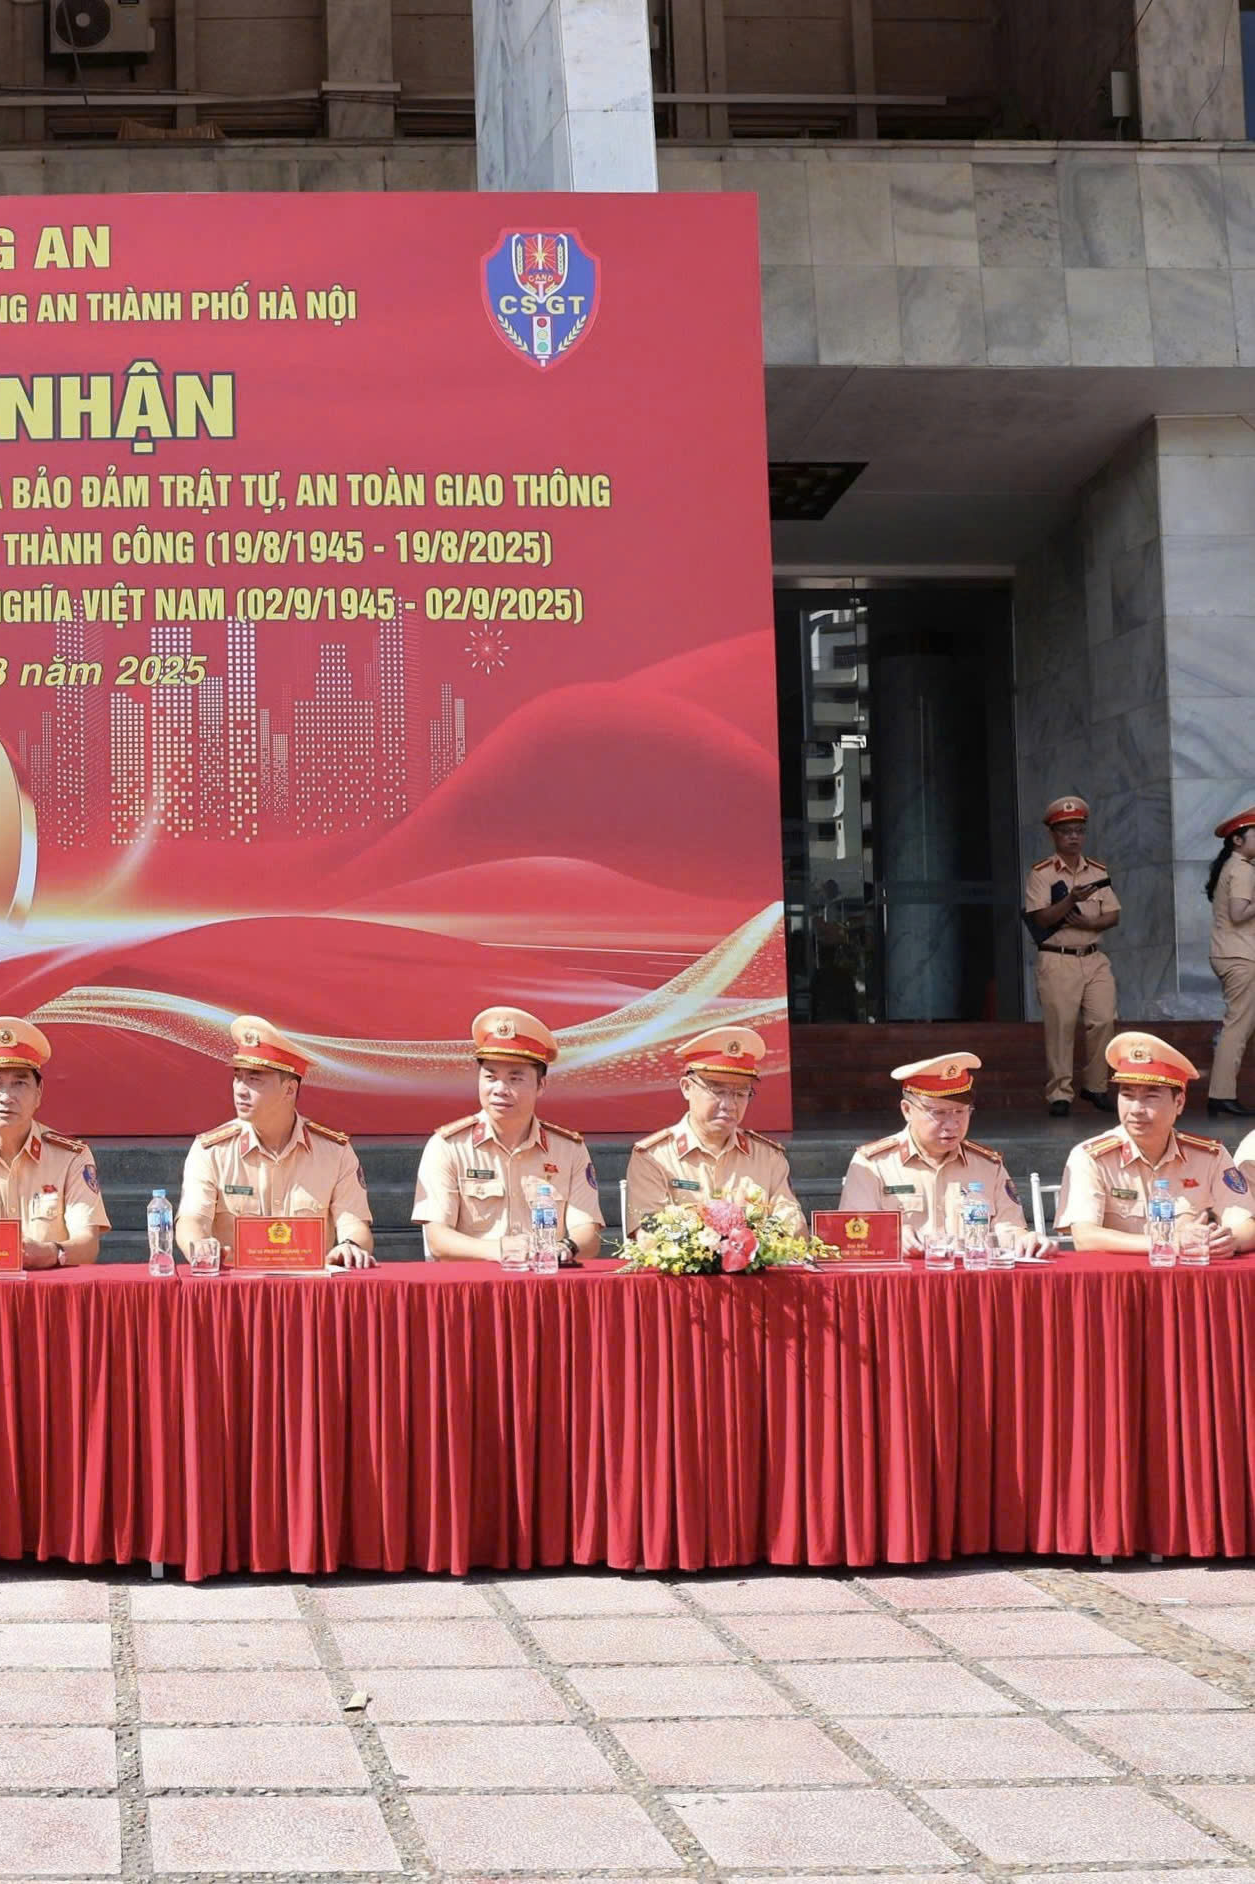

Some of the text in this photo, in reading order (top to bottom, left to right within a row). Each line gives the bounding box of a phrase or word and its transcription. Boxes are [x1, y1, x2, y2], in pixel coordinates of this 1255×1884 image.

[34, 223, 111, 270] AN
[527, 273, 554, 283] CAND
[36, 293, 78, 324] AN
[87, 287, 182, 321] THÀNH
[190, 283, 250, 321] PHỐ
[256, 284, 298, 321] HÀ
[304, 284, 357, 324] NỘI
[11, 469, 73, 510] BẢO
[80, 468, 150, 509] ĐẢM
[160, 467, 233, 513] TRẬT
[240, 471, 290, 515] TỰ,
[296, 471, 338, 508] AN
[345, 471, 426, 507] TOÀN
[434, 473, 504, 508] GIAO
[512, 468, 611, 509] THÔNG
[3, 527, 103, 566] THÀNH
[112, 525, 195, 565] CÔNG
[205, 529, 365, 566] (19/8/1945
[394, 529, 552, 566] 19/8/2025)
[80, 583, 146, 630] VIỆT
[154, 587, 226, 622] NAM
[235, 586, 396, 623] (02/9/1945
[424, 586, 586, 625] 02/9/2025)
[19, 655, 106, 689] năm
[115, 654, 207, 688] 2025
